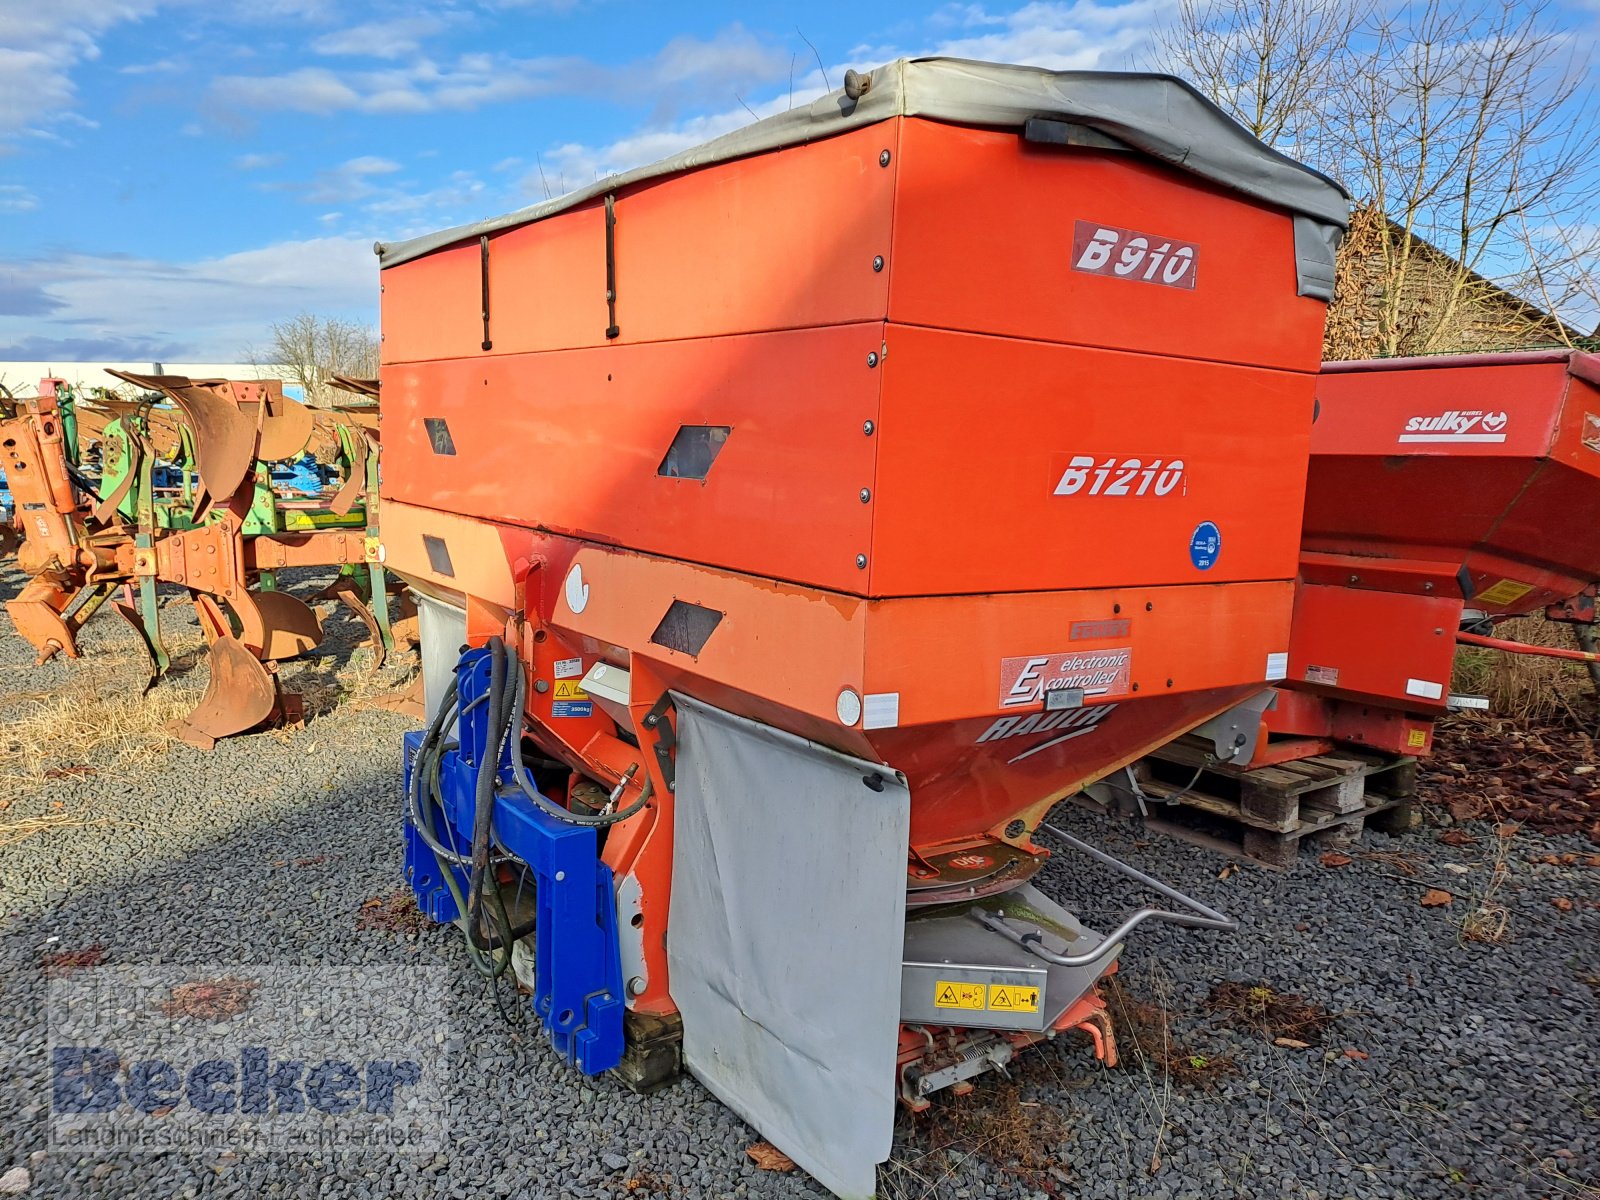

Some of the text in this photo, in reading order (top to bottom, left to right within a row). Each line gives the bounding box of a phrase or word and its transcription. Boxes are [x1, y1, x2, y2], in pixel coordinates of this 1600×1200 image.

[1404, 410, 1483, 434] sulky
[1053, 455, 1185, 496] B1210
[1060, 652, 1129, 672] electronic
[1045, 669, 1119, 690] controlled
[975, 703, 1120, 744] RAUCH
